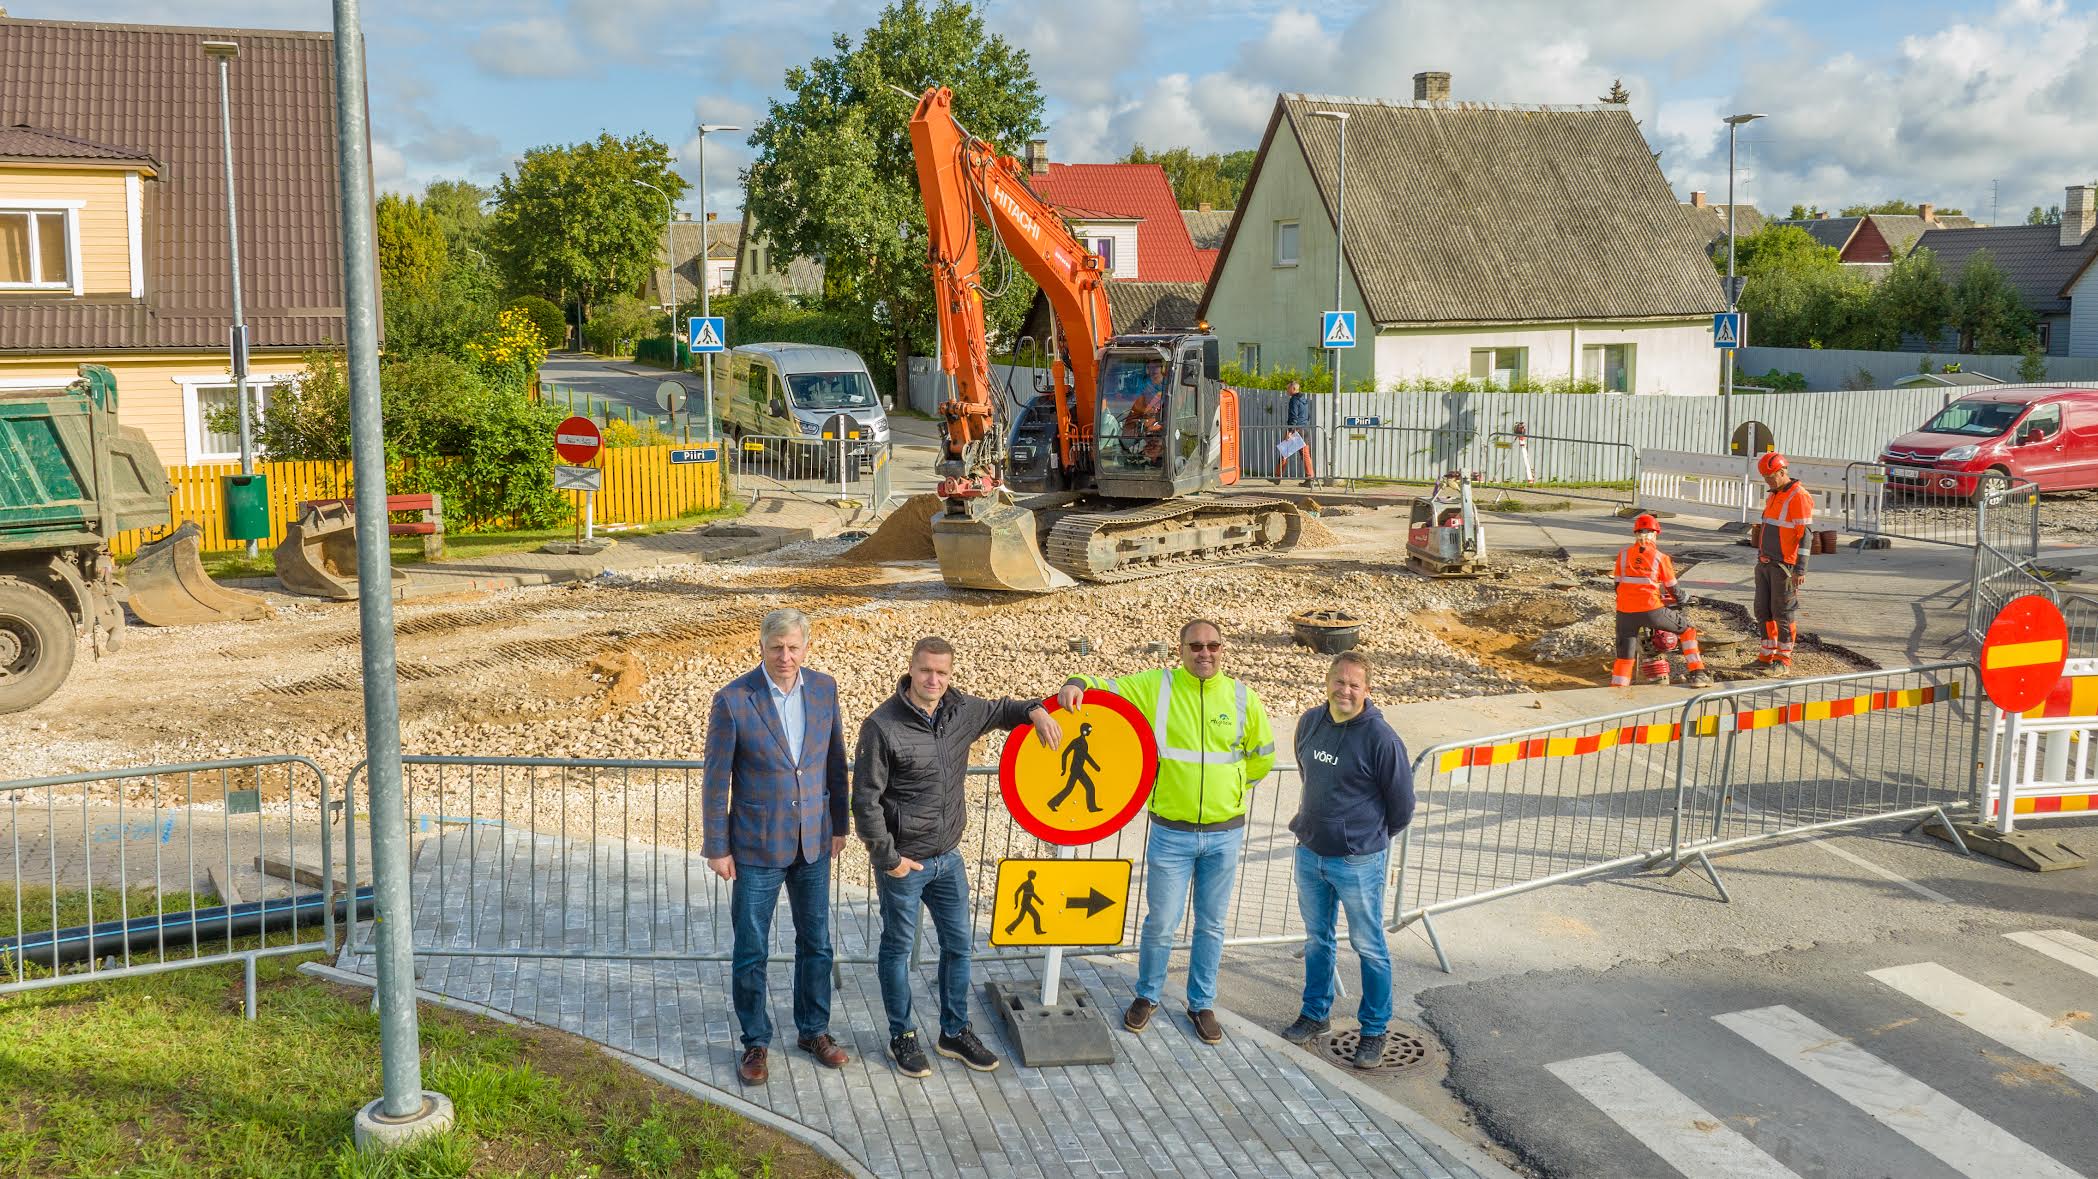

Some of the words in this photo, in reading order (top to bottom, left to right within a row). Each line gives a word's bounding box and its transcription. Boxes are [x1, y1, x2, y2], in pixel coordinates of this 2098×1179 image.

[993, 185, 1040, 240] HITACHI
[1355, 417, 1370, 425] Piiri
[684, 450, 705, 460] Piiri
[1313, 750, 1338, 765] VÕRJ
